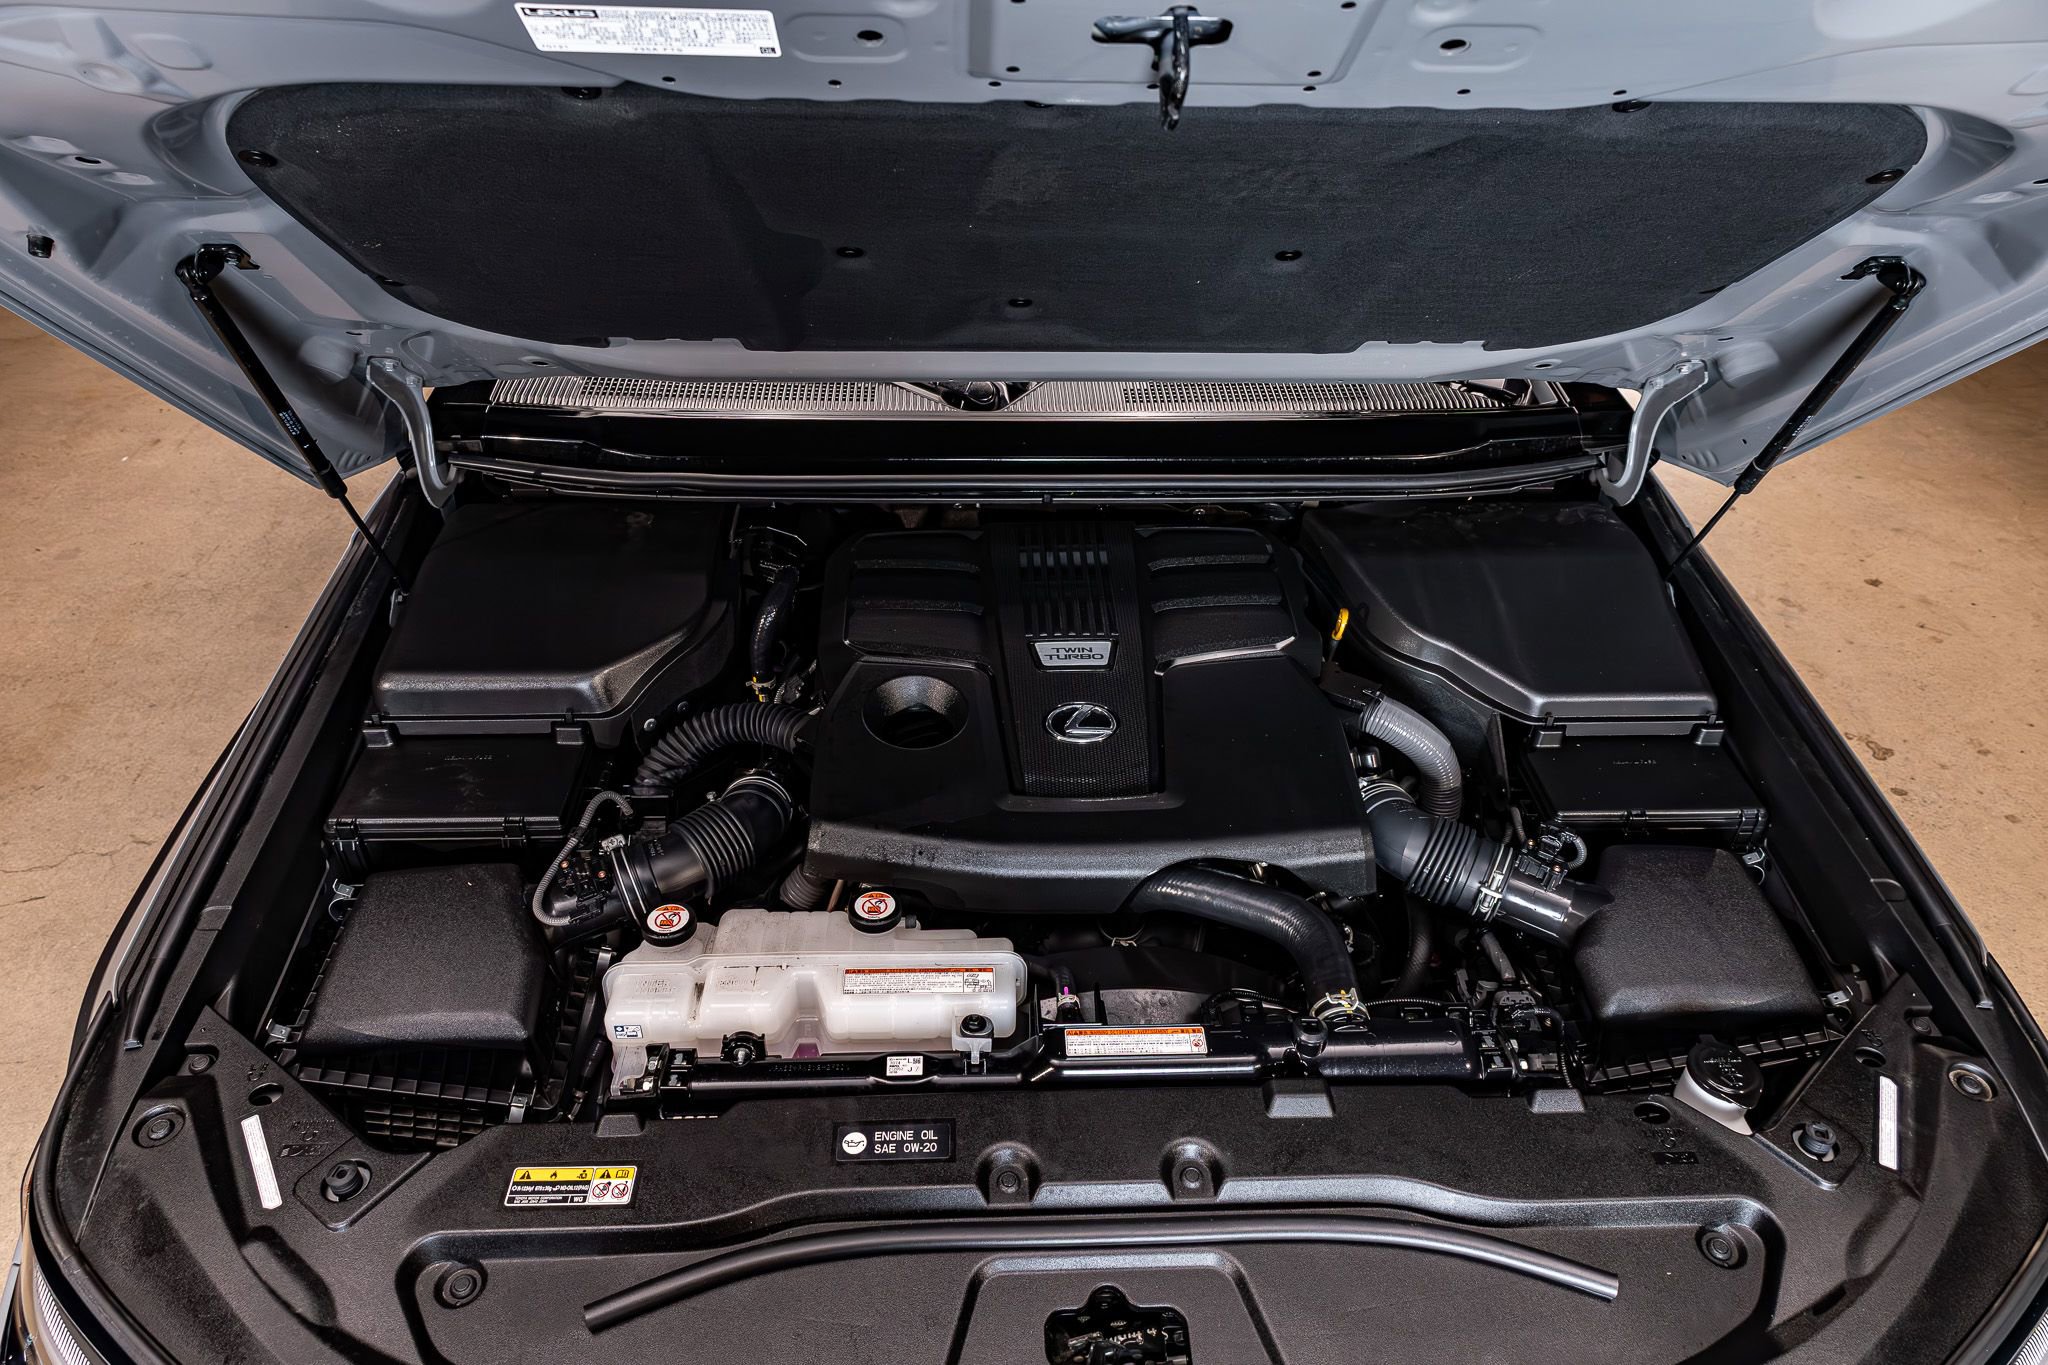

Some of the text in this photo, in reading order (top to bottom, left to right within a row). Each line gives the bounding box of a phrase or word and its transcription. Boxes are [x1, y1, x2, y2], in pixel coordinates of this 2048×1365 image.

[523, 8, 597, 18] LEXUS
[1043, 653, 1104, 661] TURBO
[874, 1129, 938, 1141] ENGINE OIL
[873, 1142, 938, 1154] SAE 0W-20
